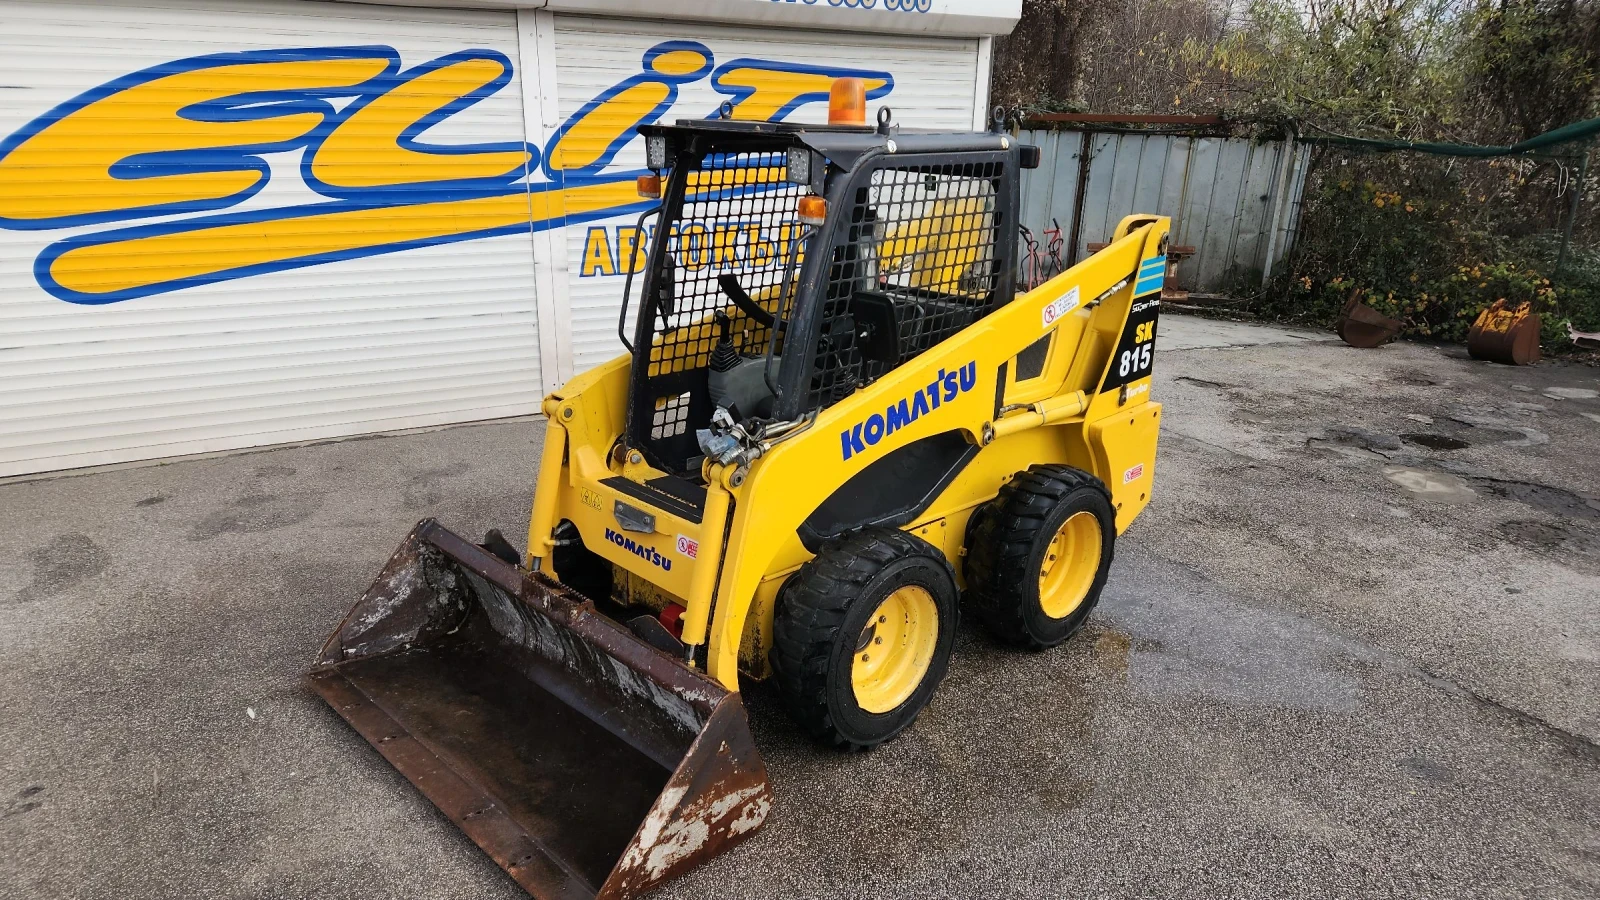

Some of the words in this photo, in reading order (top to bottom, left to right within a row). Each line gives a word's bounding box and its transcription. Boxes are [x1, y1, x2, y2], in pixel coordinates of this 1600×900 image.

[1135, 319, 1154, 344] SK
[1119, 343, 1152, 377] 815
[840, 360, 977, 461] KOMATSU
[605, 527, 672, 571] KOMATSU
